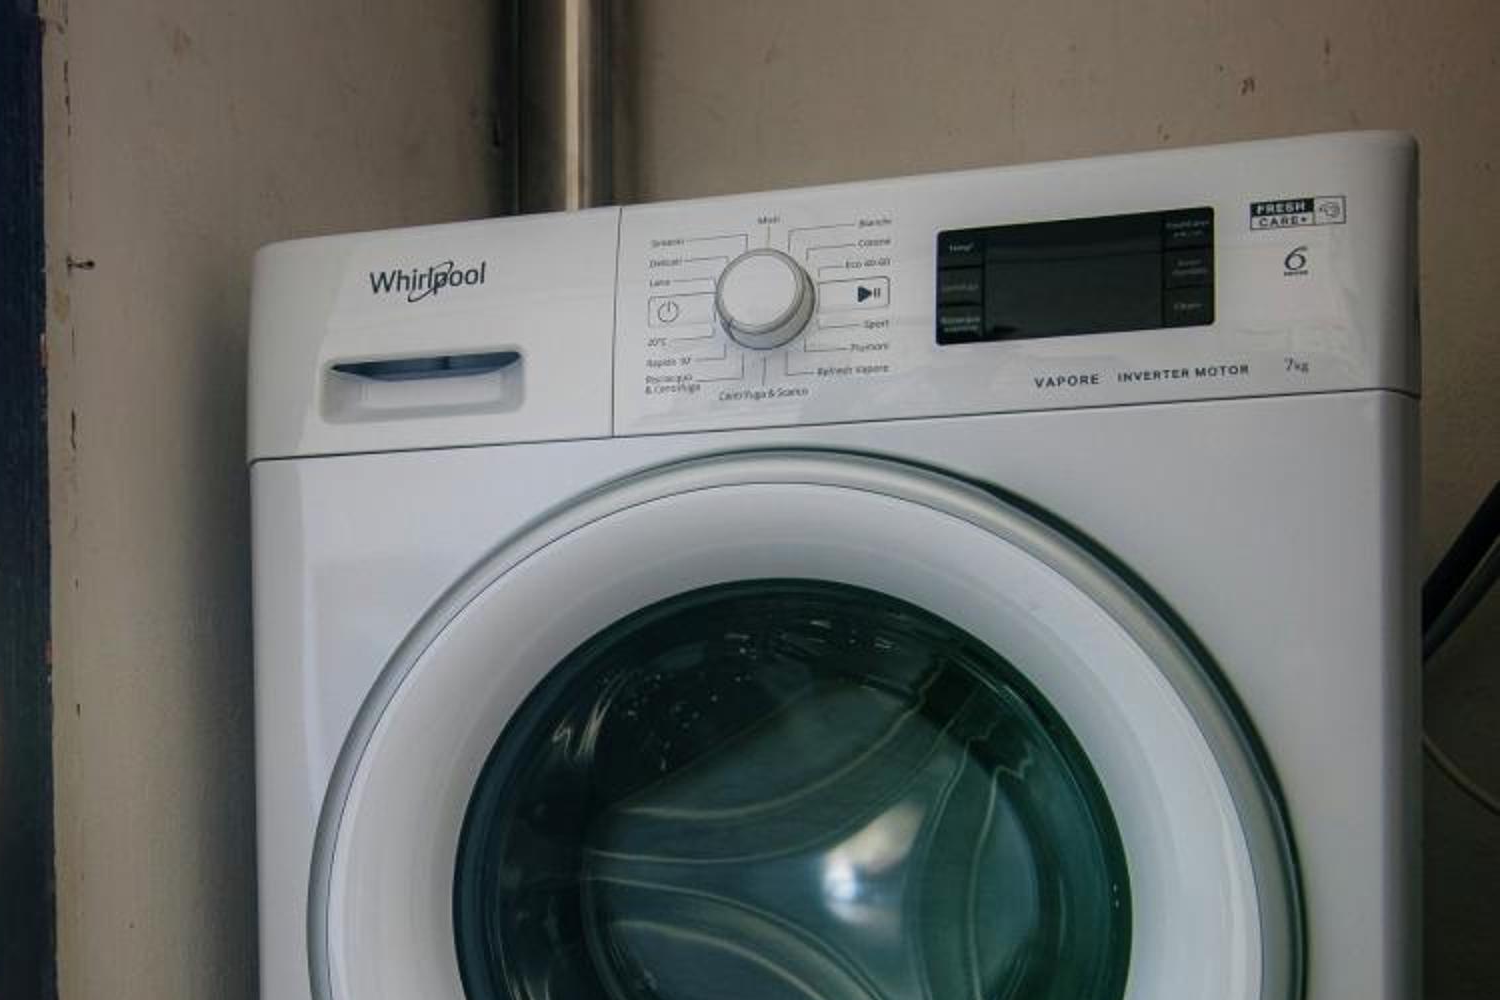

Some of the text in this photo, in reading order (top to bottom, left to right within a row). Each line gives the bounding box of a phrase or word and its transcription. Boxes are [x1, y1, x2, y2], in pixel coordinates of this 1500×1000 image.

[1256, 202, 1306, 215] FRESH
[369, 260, 486, 302] Whirlpool
[1034, 373, 1101, 388] VAPORE
[1117, 364, 1250, 383] INVERTER MOTOR
